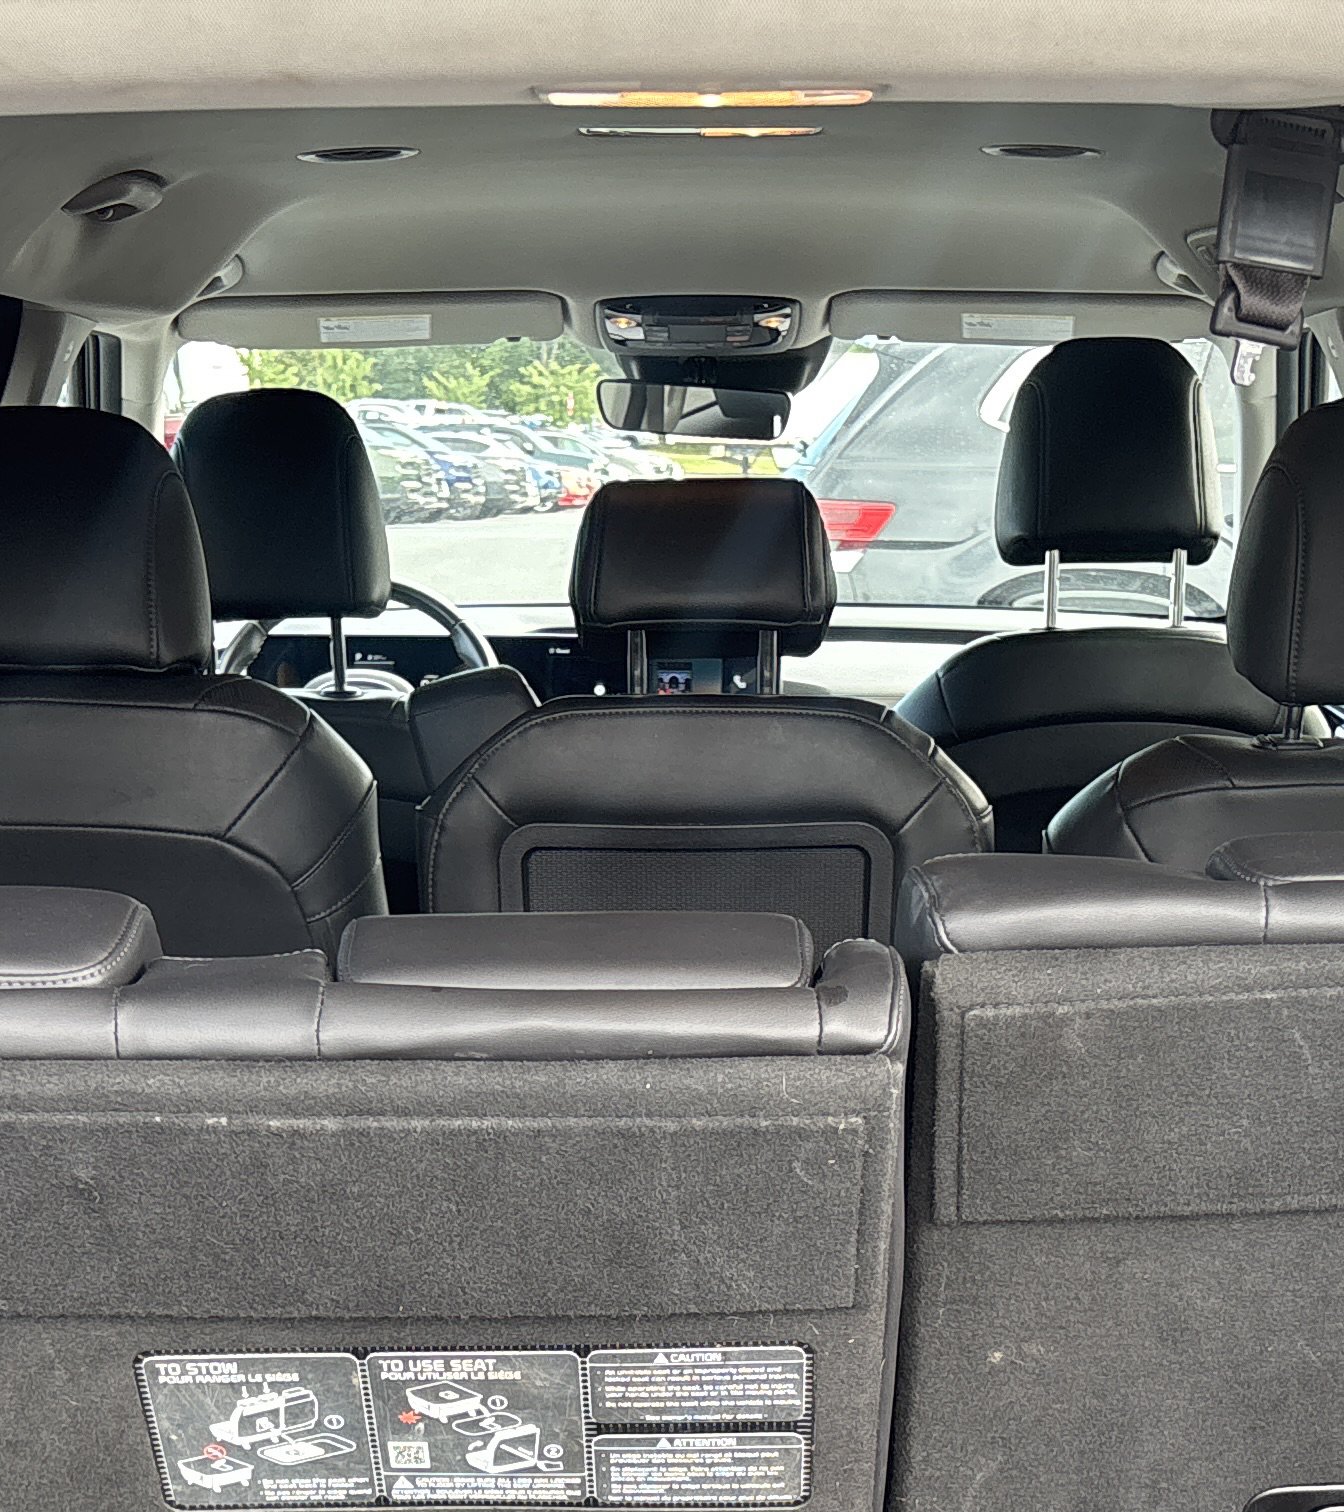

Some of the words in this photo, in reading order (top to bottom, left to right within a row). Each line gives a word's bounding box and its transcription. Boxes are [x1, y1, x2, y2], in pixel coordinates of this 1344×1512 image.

[669, 1352, 723, 1363] CAUTION
[155, 1362, 182, 1376] TO
[185, 1361, 239, 1375] STOW
[378, 1359, 405, 1372] TO
[408, 1359, 446, 1372] USE
[449, 1358, 497, 1372] SEAT
[157, 1374, 194, 1385] POUR
[195, 1373, 247, 1385] RANGER
[247, 1373, 264, 1383] LE
[380, 1371, 416, 1381] POUR
[416, 1371, 469, 1381] UTILISER
[470, 1370, 486, 1380] LE
[673, 1437, 736, 1447] ATTENTION
